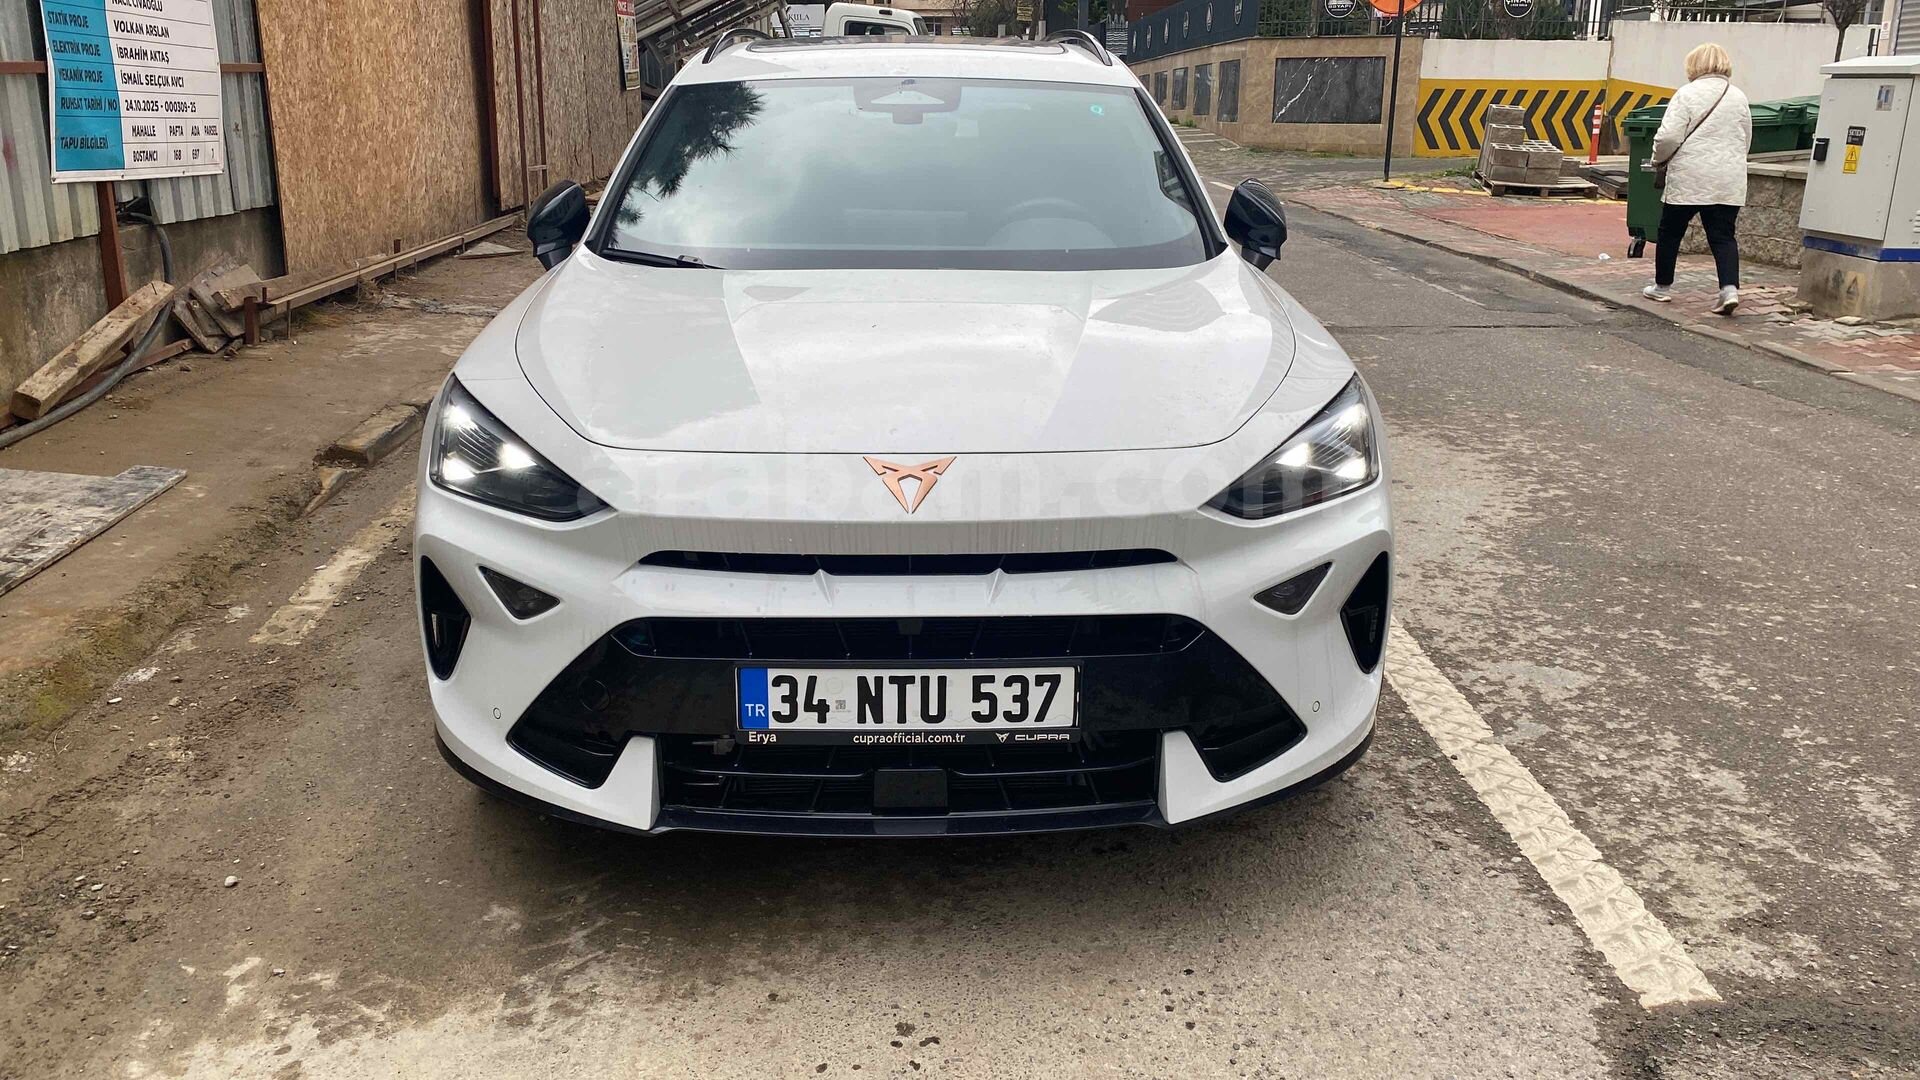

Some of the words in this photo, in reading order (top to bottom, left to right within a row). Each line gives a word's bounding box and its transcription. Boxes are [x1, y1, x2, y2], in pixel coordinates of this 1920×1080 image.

[47, 10, 69, 26] STATİK
[69, 13, 89, 29] PROJE
[113, 19, 145, 35] VOLKAN
[145, 24, 170, 38] ARSLAN
[52, 39, 81, 56] ELEKTRİK
[81, 42, 101, 57] PROJE
[116, 45, 149, 61] İBRAHİM
[149, 50, 170, 64] AKTAŞ
[84, 69, 103, 83] PROJE
[120, 69, 144, 85] İSMAİL
[145, 75, 171, 89] SELÇUK
[170, 76, 184, 88] AVCI
[60, 97, 83, 110] RUHSAT
[107, 98, 118, 111] NO
[124, 99, 159, 112] 24.10.2025
[131, 125, 156, 137] MAHALLE
[169, 125, 184, 137] PAFTA
[190, 125, 200, 136] ADA
[204, 125, 218, 136] PARSEL
[60, 137, 79, 150] TAPU
[79, 135, 109, 150] BİLGİLERİ
[133, 149, 158, 163] BOSTANCI
[173, 149, 182, 161] 168
[771, 674, 830, 724] 34
[856, 675, 948, 724] NTU
[971, 674, 1062, 723] 537
[745, 704, 766, 717] TR
[748, 731, 777, 744] Erya
[853, 732, 966, 744] cupraofficial.com.tr
